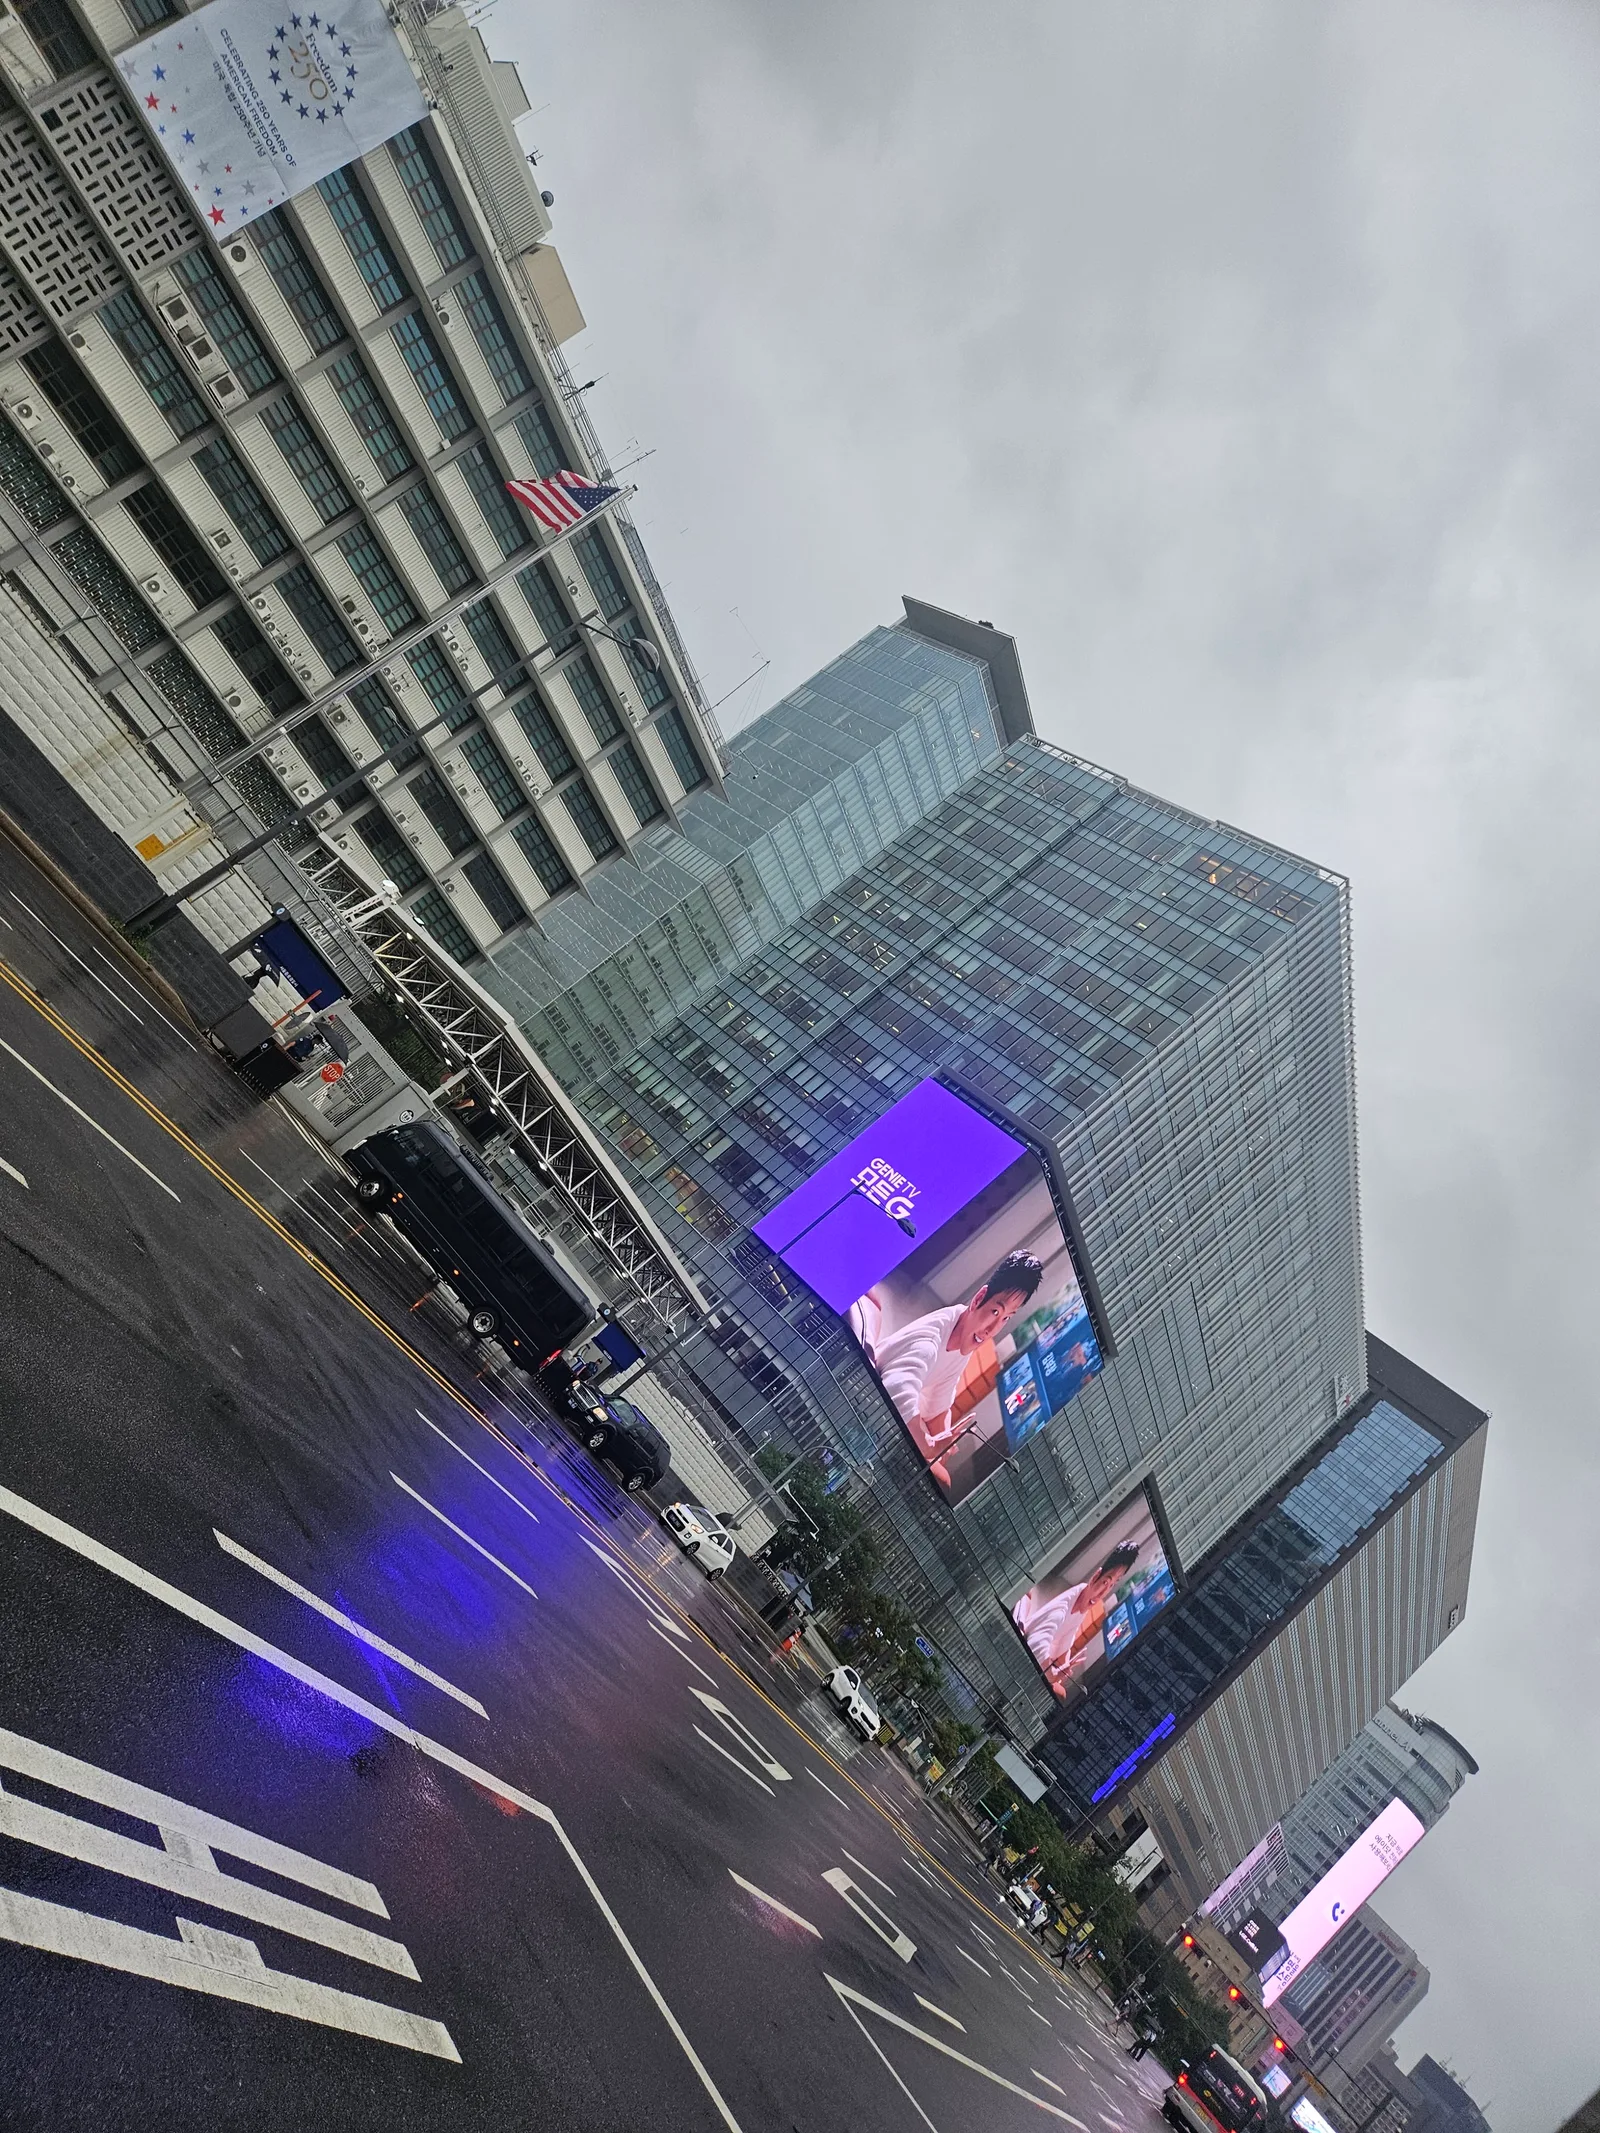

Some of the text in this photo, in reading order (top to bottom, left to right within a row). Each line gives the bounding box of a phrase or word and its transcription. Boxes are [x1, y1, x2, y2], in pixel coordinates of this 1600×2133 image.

[287, 41, 329, 101] 250
[306, 32, 338, 94] Freedom
[212, 60, 267, 158] 미국 독립 250주년 기념
[220, 27, 297, 168] CELEBRATING 250 YEARS OF
[220, 53, 278, 157] AMERICAN FREEDOM
[324, 1064, 341, 1080] STOP
[870, 1157, 922, 1199] GENIE TV
[1004, 1385, 1027, 1415] kt
[1374, 1834, 1392, 1854] 에이닷
[1385, 1832, 1398, 1848] 지금
